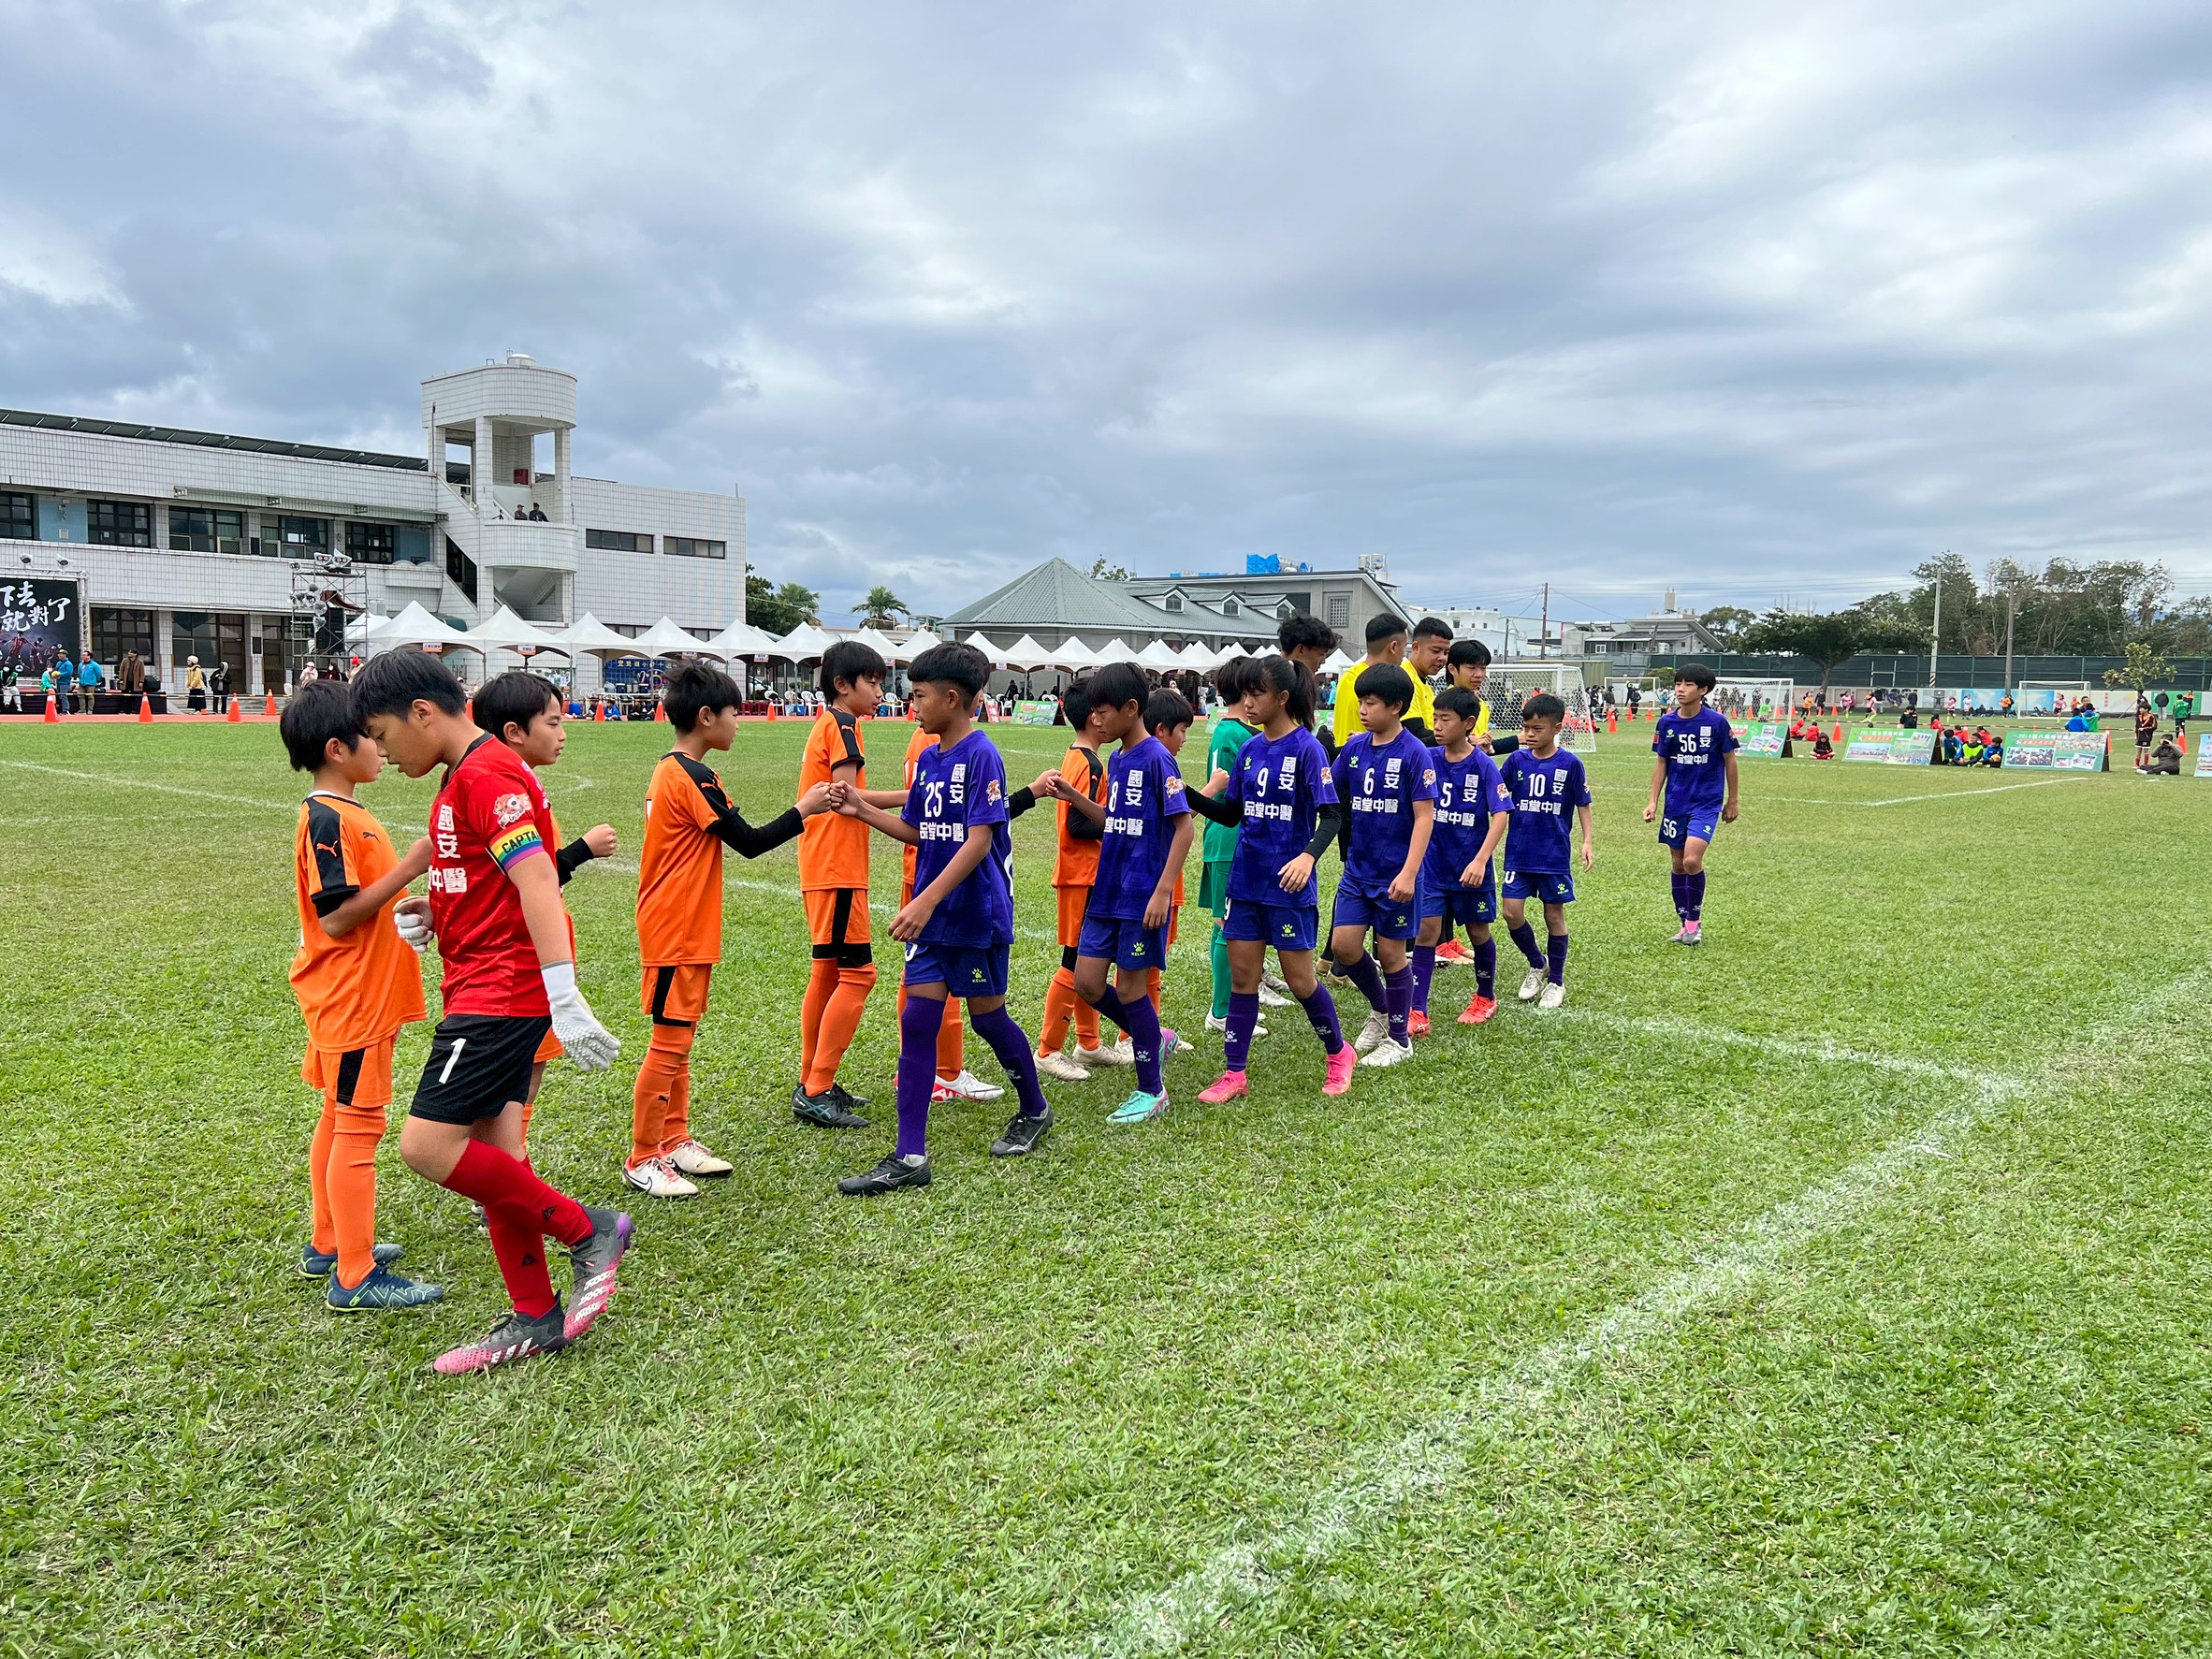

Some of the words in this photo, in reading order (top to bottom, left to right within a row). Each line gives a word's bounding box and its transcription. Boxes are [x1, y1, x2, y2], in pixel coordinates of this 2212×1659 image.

[1679, 734, 1696, 753] 56
[949, 764, 967, 805] 國安
[1125, 769, 1143, 807] 國安
[1257, 767, 1269, 797] 9
[1277, 756, 1297, 792] 國安
[1363, 767, 1375, 795] 6
[1384, 758, 1403, 790] 國安
[1463, 774, 1479, 803] 國安
[1528, 773, 1545, 797] 10
[1551, 768, 1568, 796] 國安
[924, 781, 945, 818] 25
[1108, 780, 1119, 813] 8
[1350, 795, 1399, 813] 品堂中醫
[1439, 781, 1453, 808] 5
[437, 804, 461, 859] 國安
[1663, 817, 1678, 838] 56
[438, 1038, 467, 1084] 1
